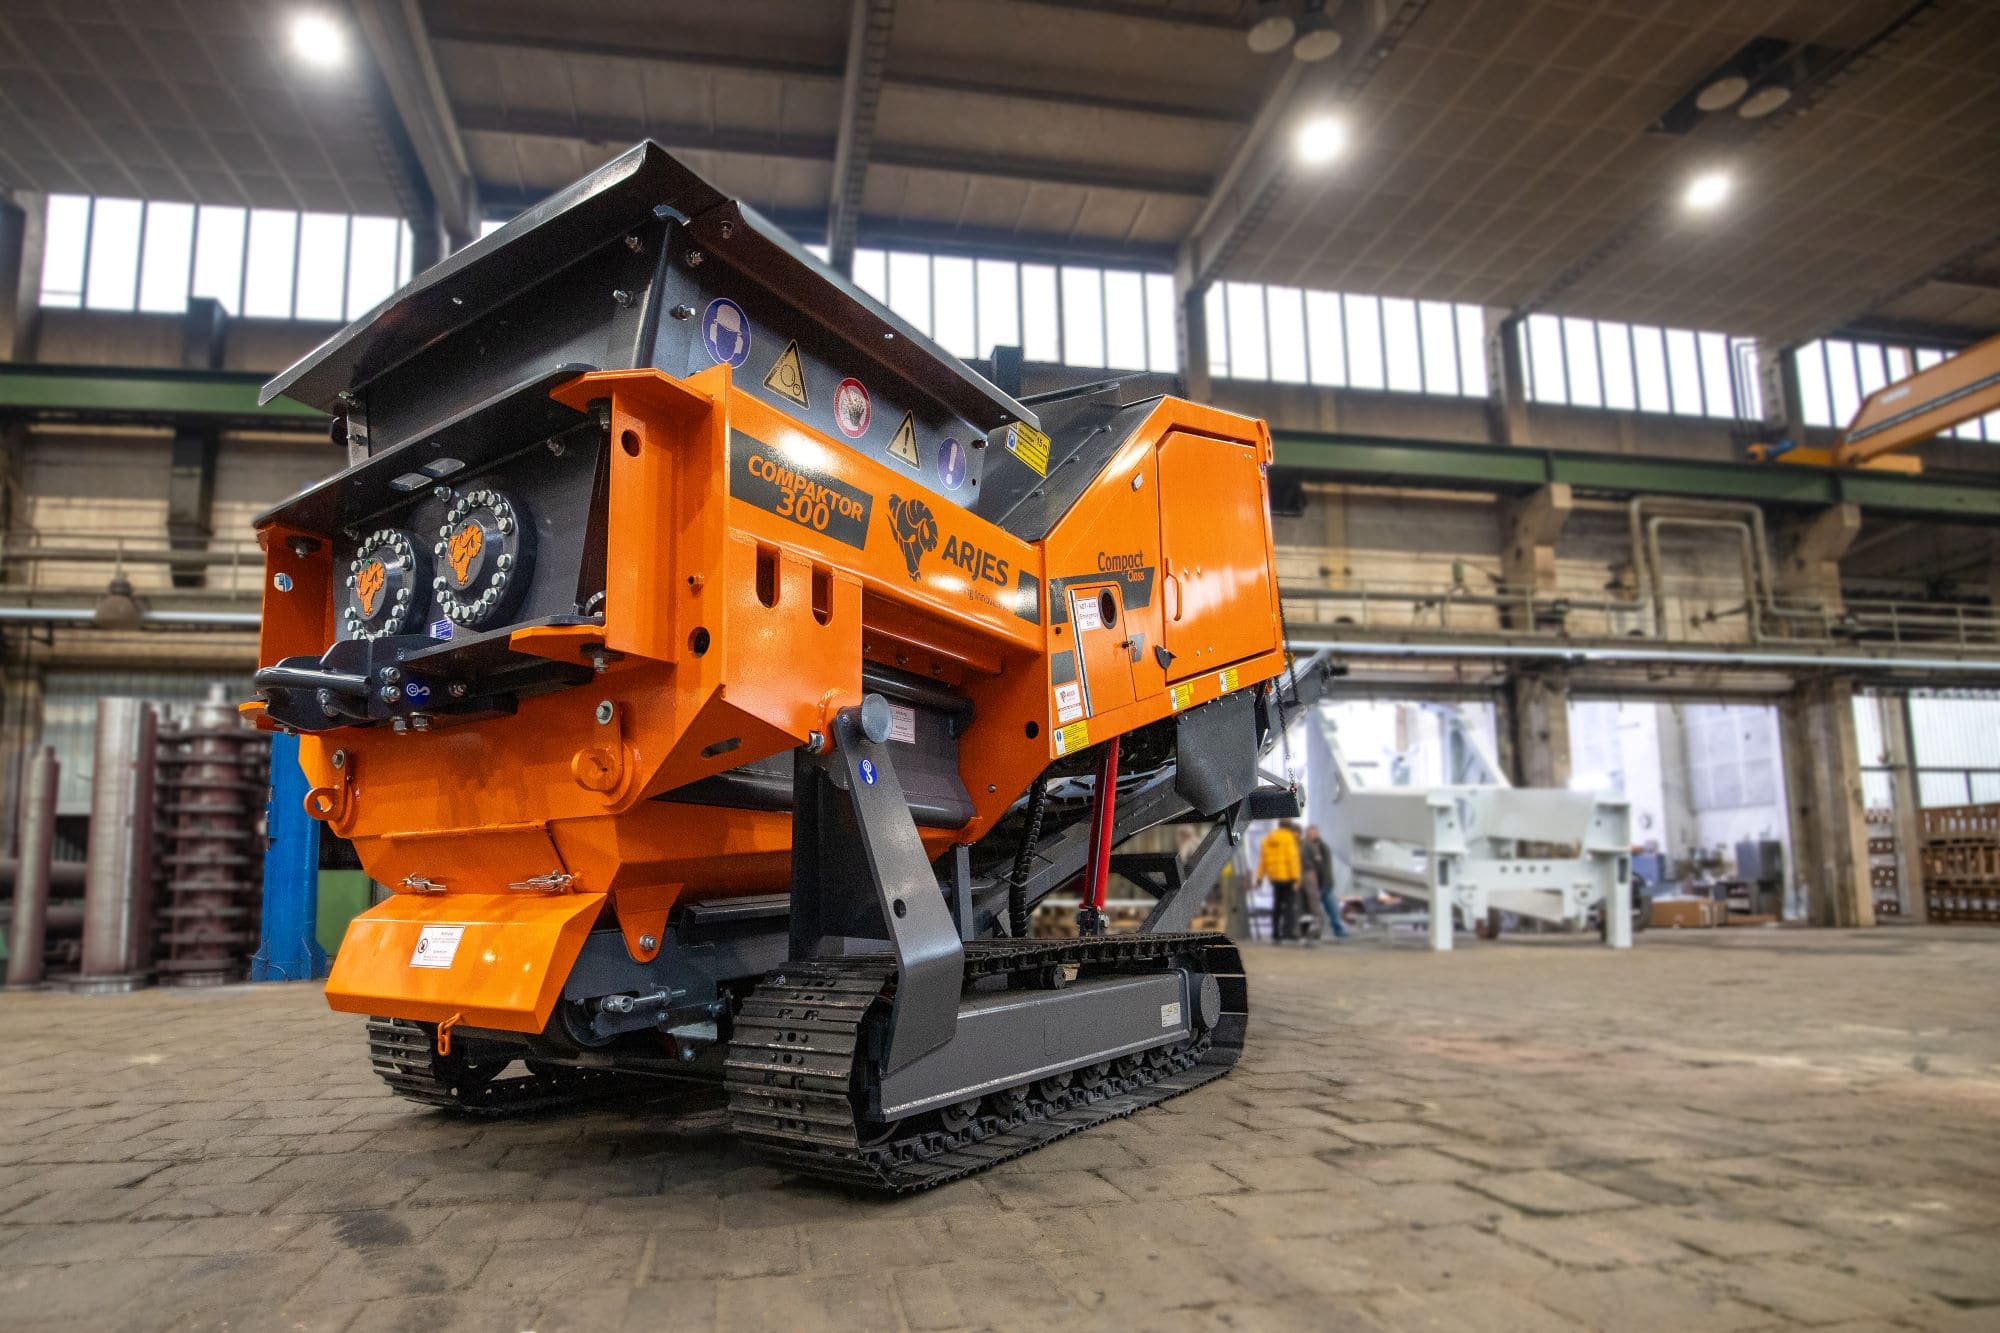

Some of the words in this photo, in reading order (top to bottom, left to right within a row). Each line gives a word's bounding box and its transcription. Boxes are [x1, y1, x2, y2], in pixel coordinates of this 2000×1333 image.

[748, 455, 863, 522] COMPAKTOR
[776, 486, 829, 530] 300
[942, 535, 1008, 587] ARJES
[1098, 550, 1143, 573] Compact
[1128, 570, 1144, 582] Class
